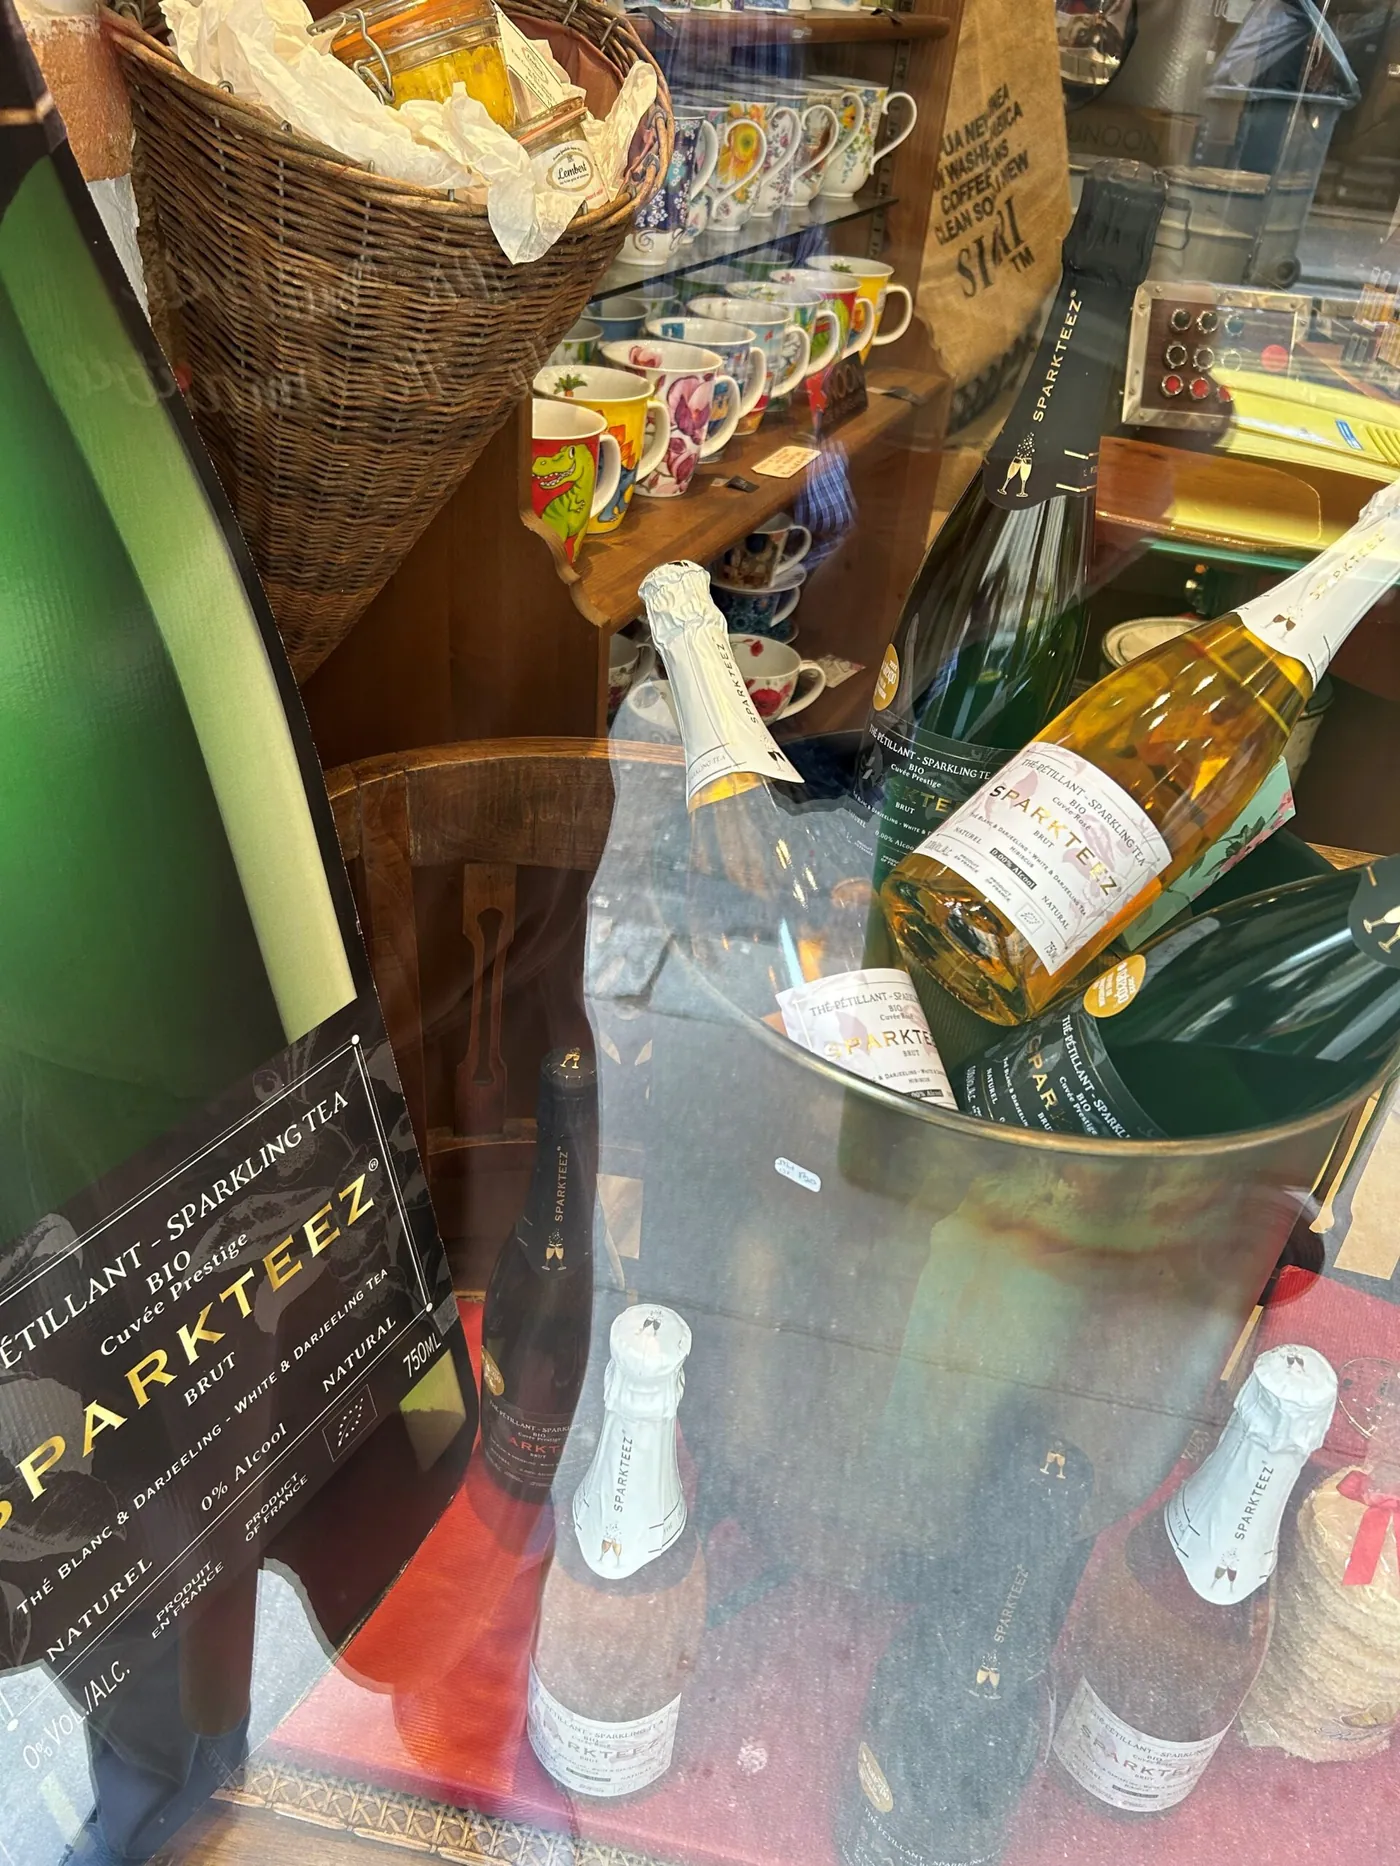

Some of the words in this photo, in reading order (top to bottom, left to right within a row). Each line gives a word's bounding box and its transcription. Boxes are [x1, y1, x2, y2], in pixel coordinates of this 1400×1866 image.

[557, 160, 588, 181] Lembert
[877, 732, 917, 761] PÉTILLANT
[921, 756, 978, 779] SPARKLING
[890, 763, 910, 778] Cuvée
[911, 772, 943, 789] Prestige
[908, 763, 925, 775] BIO
[895, 802, 916, 815] BRUT
[1038, 763, 1086, 797] PÉTILLANT
[1088, 798, 1136, 849] SPARKLING
[1131, 844, 1146, 867] TEA
[1052, 796, 1075, 818] Cuvée
[1073, 814, 1091, 832] Rosé
[1069, 799, 1087, 815] BIO
[894, 839, 914, 851] Alcoo
[989, 785, 1119, 897] SPARKTEEZ
[1033, 829, 1055, 849] BRUT
[991, 849, 1013, 868] 0.00%
[1011, 866, 1037, 890] Alcool
[1041, 895, 1070, 931] NATURAL
[835, 991, 887, 1010] PÉTILLANT
[889, 1004, 903, 1013] BIO
[824, 1028, 936, 1061] SPARKTE
[1062, 1014, 1074, 1035] THÉ
[1064, 1032, 1096, 1093] PÉTILLANT
[986, 1067, 997, 1105] NATUREL
[1059, 1076, 1075, 1103] Cuvée
[1072, 1103, 1098, 1136] Prestige
[1076, 1092, 1092, 1113] BIO
[1011, 1093, 1029, 1127] DARJEELIN
[1037, 1112, 1053, 1132] BRU
[1093, 1098, 1131, 1139] SPARKL
[0, 1241, 142, 1370] ÉTILLANT
[169, 1122, 303, 1243] SPARKLING
[303, 1090, 349, 1133] TEA
[145, 1249, 193, 1296] BIO
[100, 1302, 166, 1358] Cuvée
[169, 1231, 249, 1303] Prestige
[402, 1332, 445, 1379] 750ML
[184, 1352, 237, 1407] BRUT
[17, 1577, 54, 1615] THÉ
[57, 1526, 113, 1580] BLANC
[117, 1511, 130, 1525] &
[133, 1423, 223, 1510] DARJEELING
[234, 1369, 278, 1415] WHITE
[280, 1360, 291, 1374] &
[292, 1290, 365, 1359] DARJEELING
[366, 1267, 389, 1288] TEA
[46, 1557, 153, 1663] NATUREL
[201, 1481, 228, 1511] 0%
[234, 1422, 288, 1482] Alcool
[322, 1316, 397, 1394] NATURAL
[245, 1472, 298, 1530] PRODUCT
[245, 1522, 260, 1542] OF
[263, 1474, 308, 1524] FRANCE
[151, 1617, 171, 1640] EN
[173, 1561, 224, 1617] FRANCE
[156, 1560, 212, 1622] PRODUIT
[23, 1738, 53, 1770] 0%
